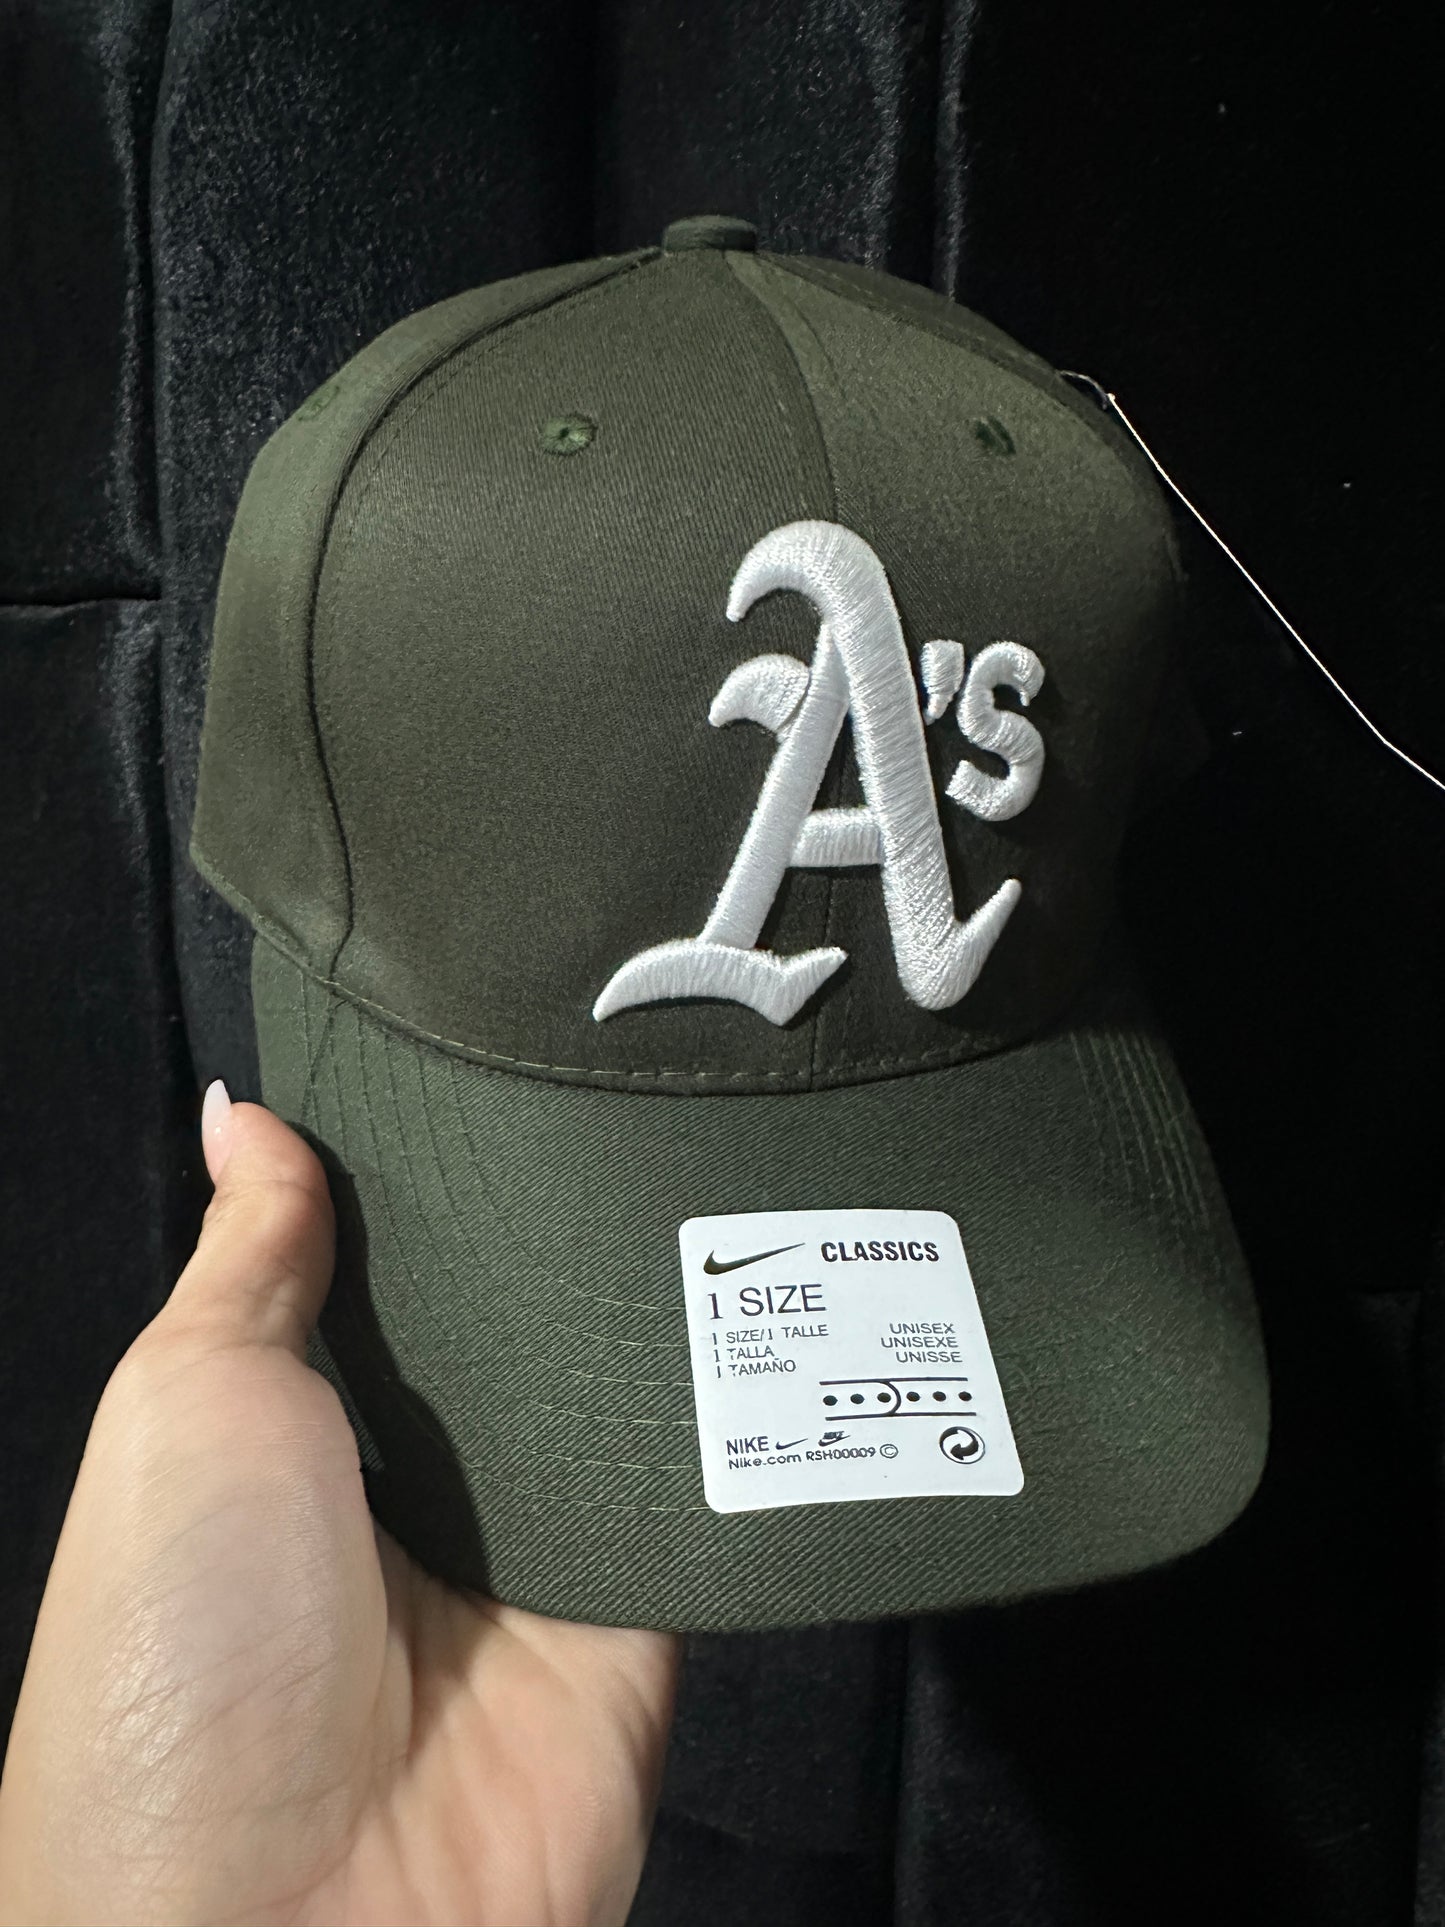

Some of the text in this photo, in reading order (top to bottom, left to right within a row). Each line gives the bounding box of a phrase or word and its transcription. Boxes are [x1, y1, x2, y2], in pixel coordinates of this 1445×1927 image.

[593, 520, 1045, 1026] A's
[821, 1241, 939, 1262] CLASSICS
[708, 1284, 826, 1319] 1 SIZE
[781, 1324, 829, 1339] TALLE
[889, 1323, 956, 1335] UNISEX
[881, 1336, 959, 1348] UNISEXE
[726, 1345, 775, 1360] TALLA
[895, 1351, 963, 1363] UNISSE
[728, 1358, 796, 1376] TAMAÑO
[726, 1436, 770, 1455] NIKE
[728, 1454, 801, 1469] Nike.com
